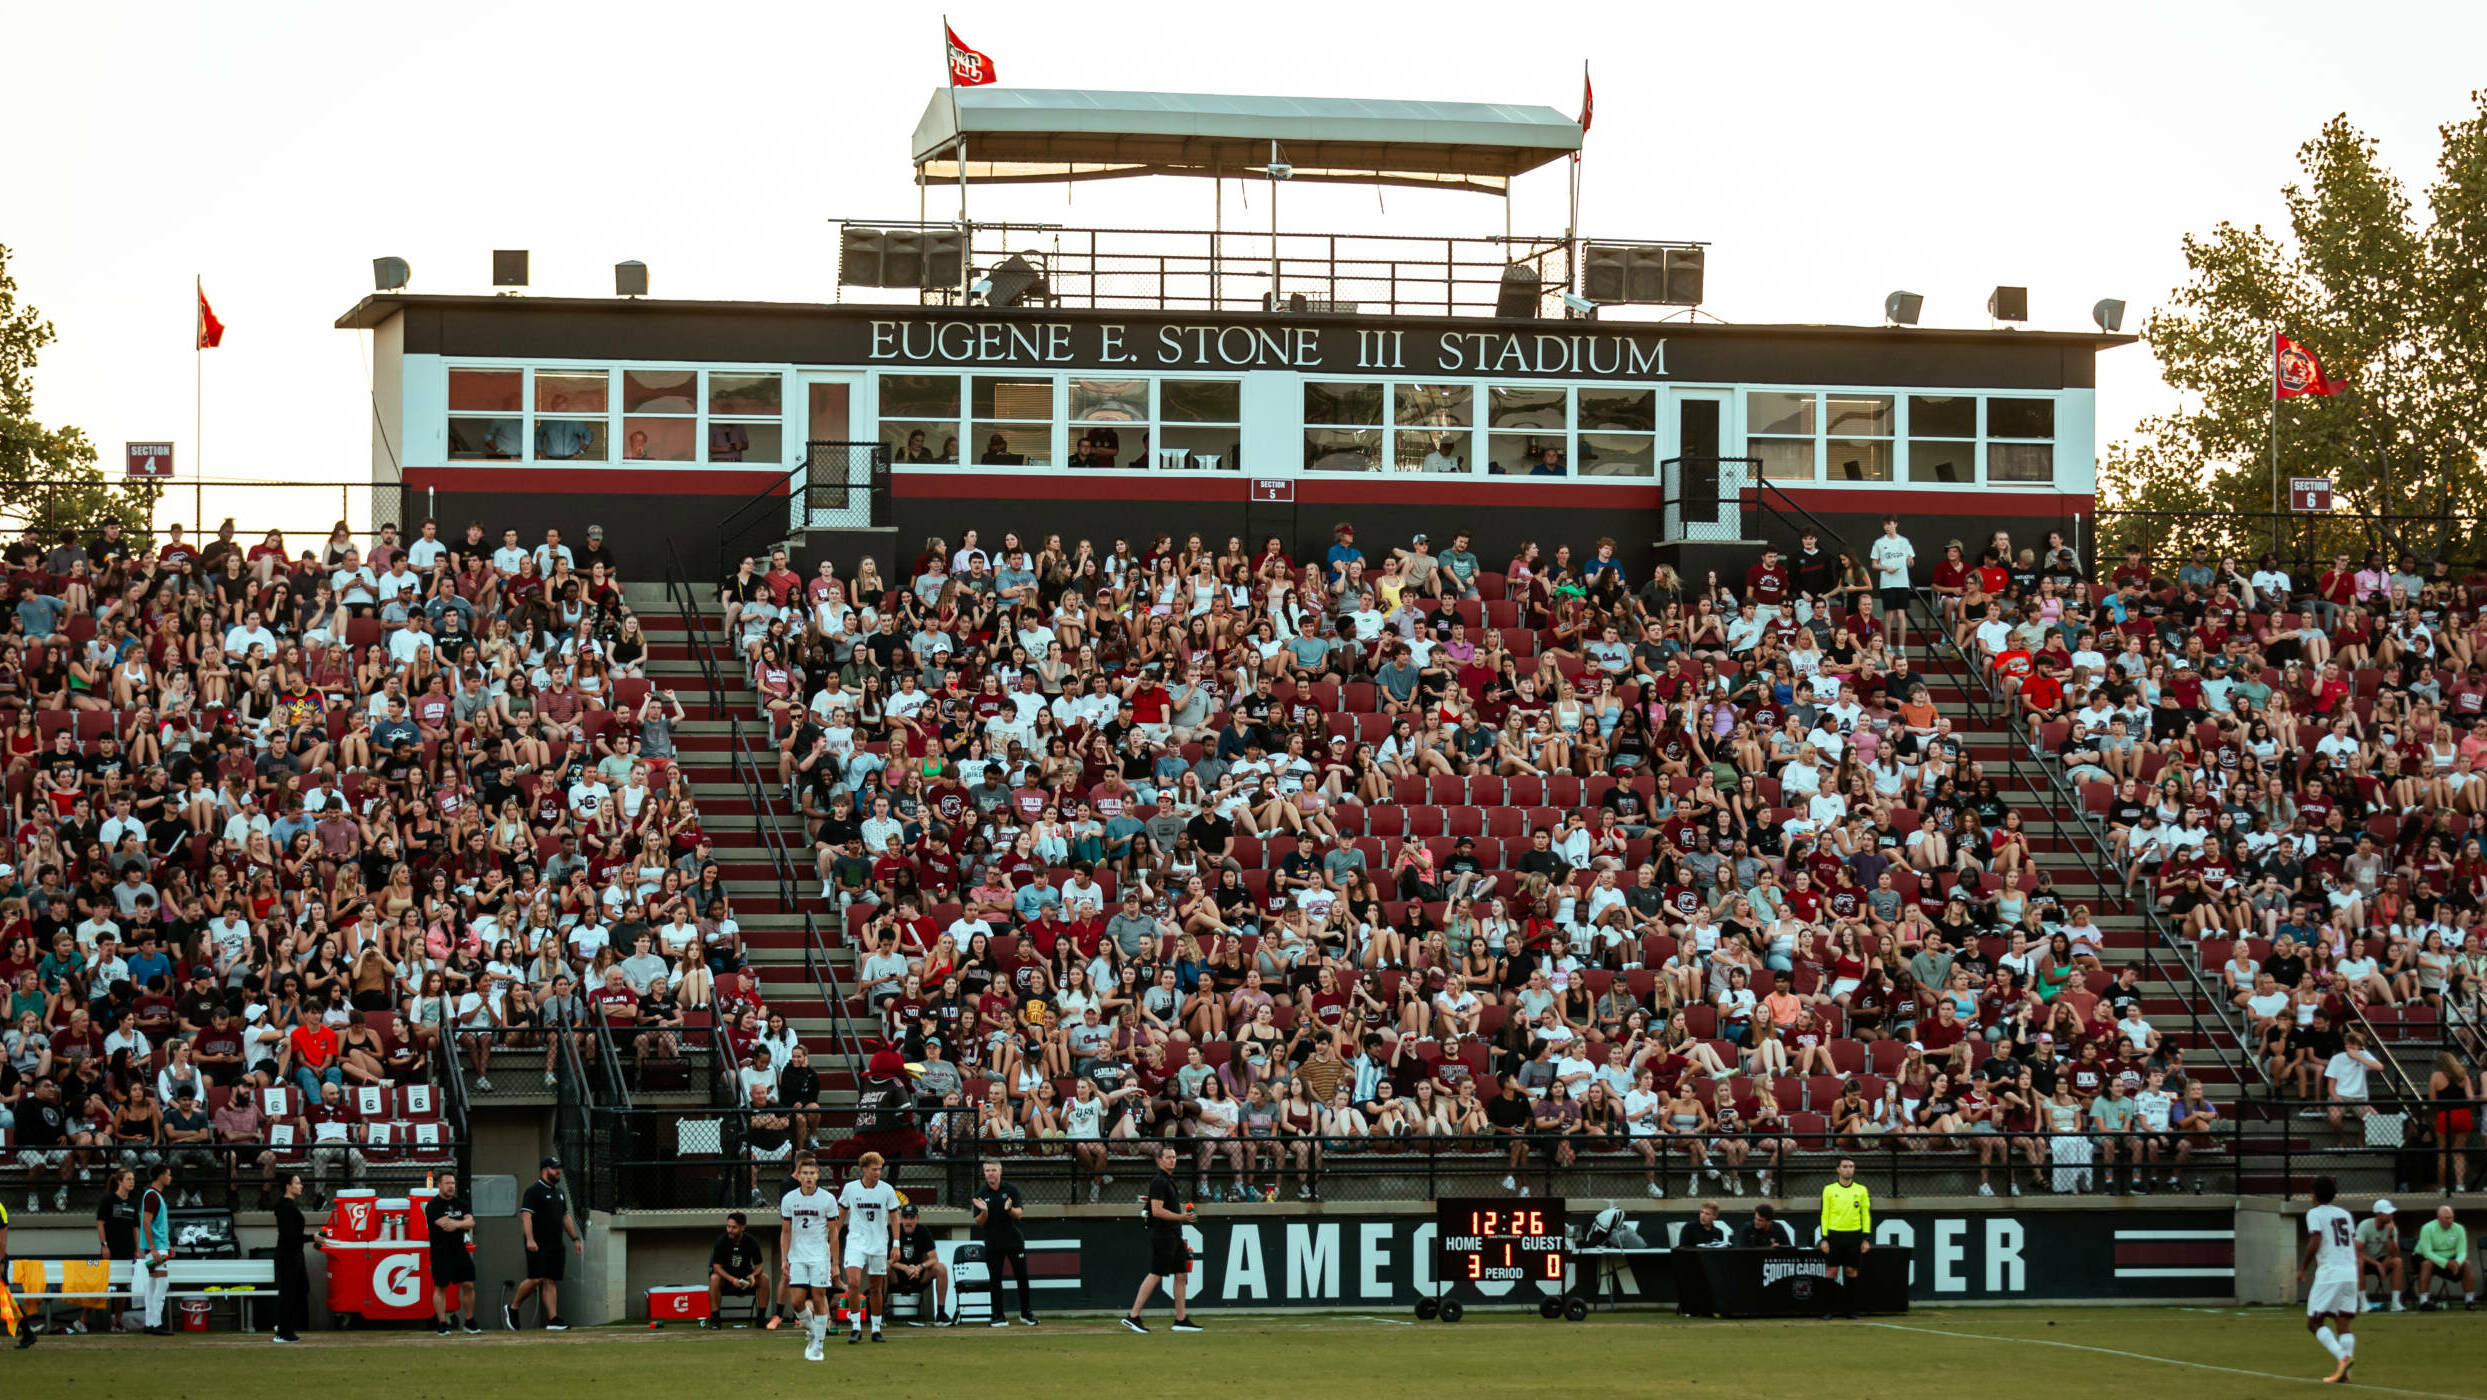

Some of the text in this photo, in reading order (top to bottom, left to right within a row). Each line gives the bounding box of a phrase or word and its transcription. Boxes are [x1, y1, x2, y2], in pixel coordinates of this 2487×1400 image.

[868, 321, 1669, 376] EUGENE E. STONE III STADIUM
[131, 446, 170, 456] SECTION
[144, 456, 157, 474] 4
[1260, 480, 1285, 488] SECTION
[2294, 481, 2329, 491] SECTION
[1269, 489, 1277, 499] 5
[2306, 492, 2316, 508] 6
[802, 1218, 809, 1229] 2
[866, 1210, 875, 1222] 13
[1472, 1210, 1544, 1236] 12:26
[2331, 1217, 2350, 1248] 15
[1446, 1236, 1483, 1251] HOME
[1521, 1236, 1563, 1251] GUEST
[1504, 1243, 1512, 1267] 1
[1468, 1254, 1481, 1278] 3
[1485, 1267, 1524, 1279] PERIOD
[1546, 1254, 1561, 1278] 0
[372, 1253, 420, 1307] G
[1763, 1262, 1844, 1287] SOUTH CAROLA
